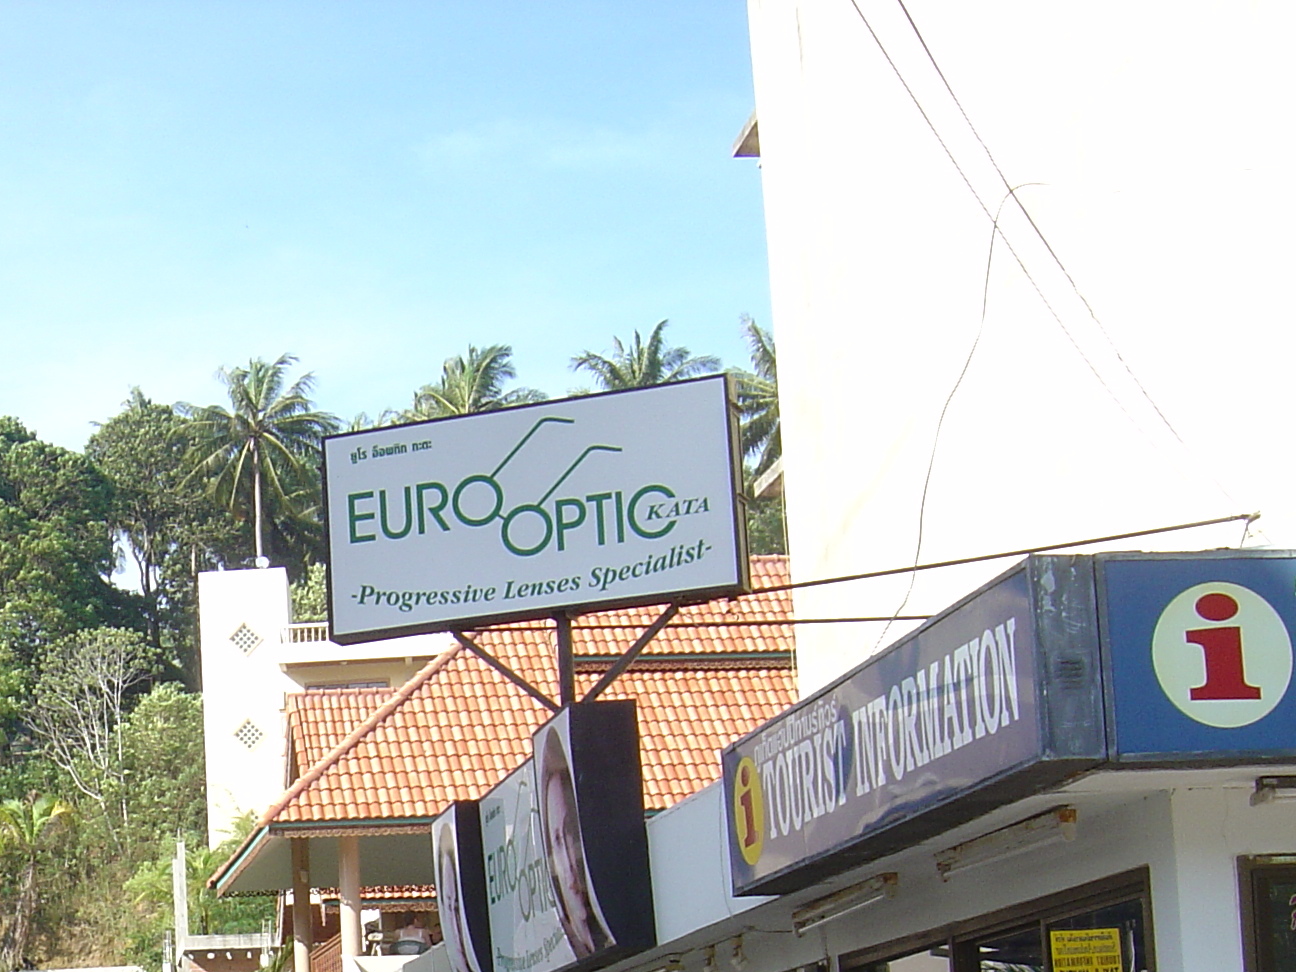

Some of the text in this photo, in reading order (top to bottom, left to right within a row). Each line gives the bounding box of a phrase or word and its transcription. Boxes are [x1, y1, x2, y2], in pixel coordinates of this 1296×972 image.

[347, 474, 505, 544] EURO
[501, 484, 711, 557] OPTIC KATA
[503, 574, 582, 601] Lenses
[762, 616, 1021, 841] TOURIST INFORMATION
